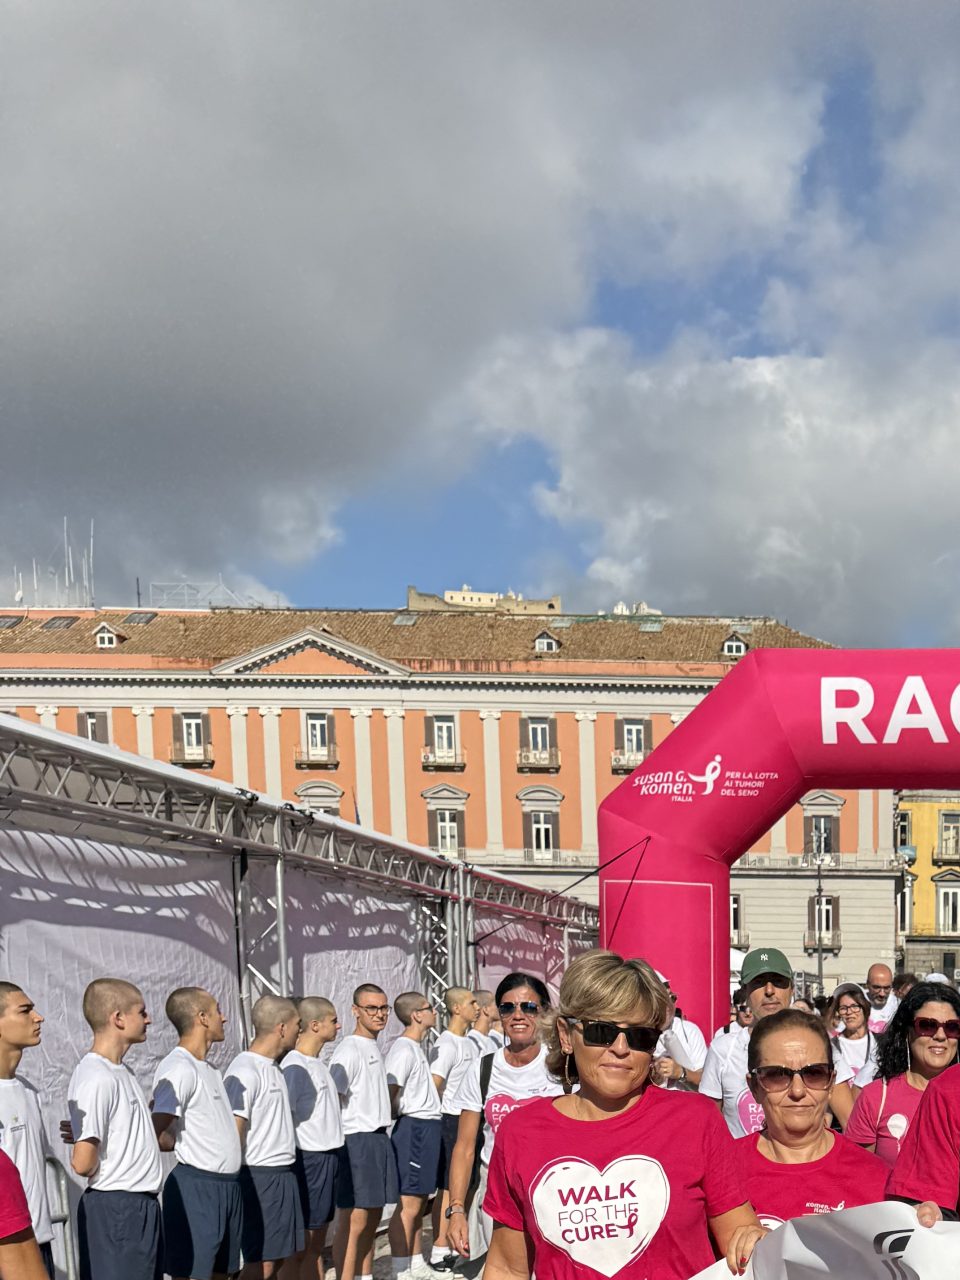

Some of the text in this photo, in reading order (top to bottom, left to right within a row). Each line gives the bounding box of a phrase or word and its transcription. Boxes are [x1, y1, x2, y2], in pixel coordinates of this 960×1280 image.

[742, 772, 753, 780] LA
[754, 772, 778, 780] LOTTA
[724, 780, 764, 788] AI TUMORI
[720, 788, 736, 796] DEL
[558, 1180, 636, 1206] WALK
[558, 1208, 598, 1226] FOR
[562, 1224, 618, 1244] CURE
